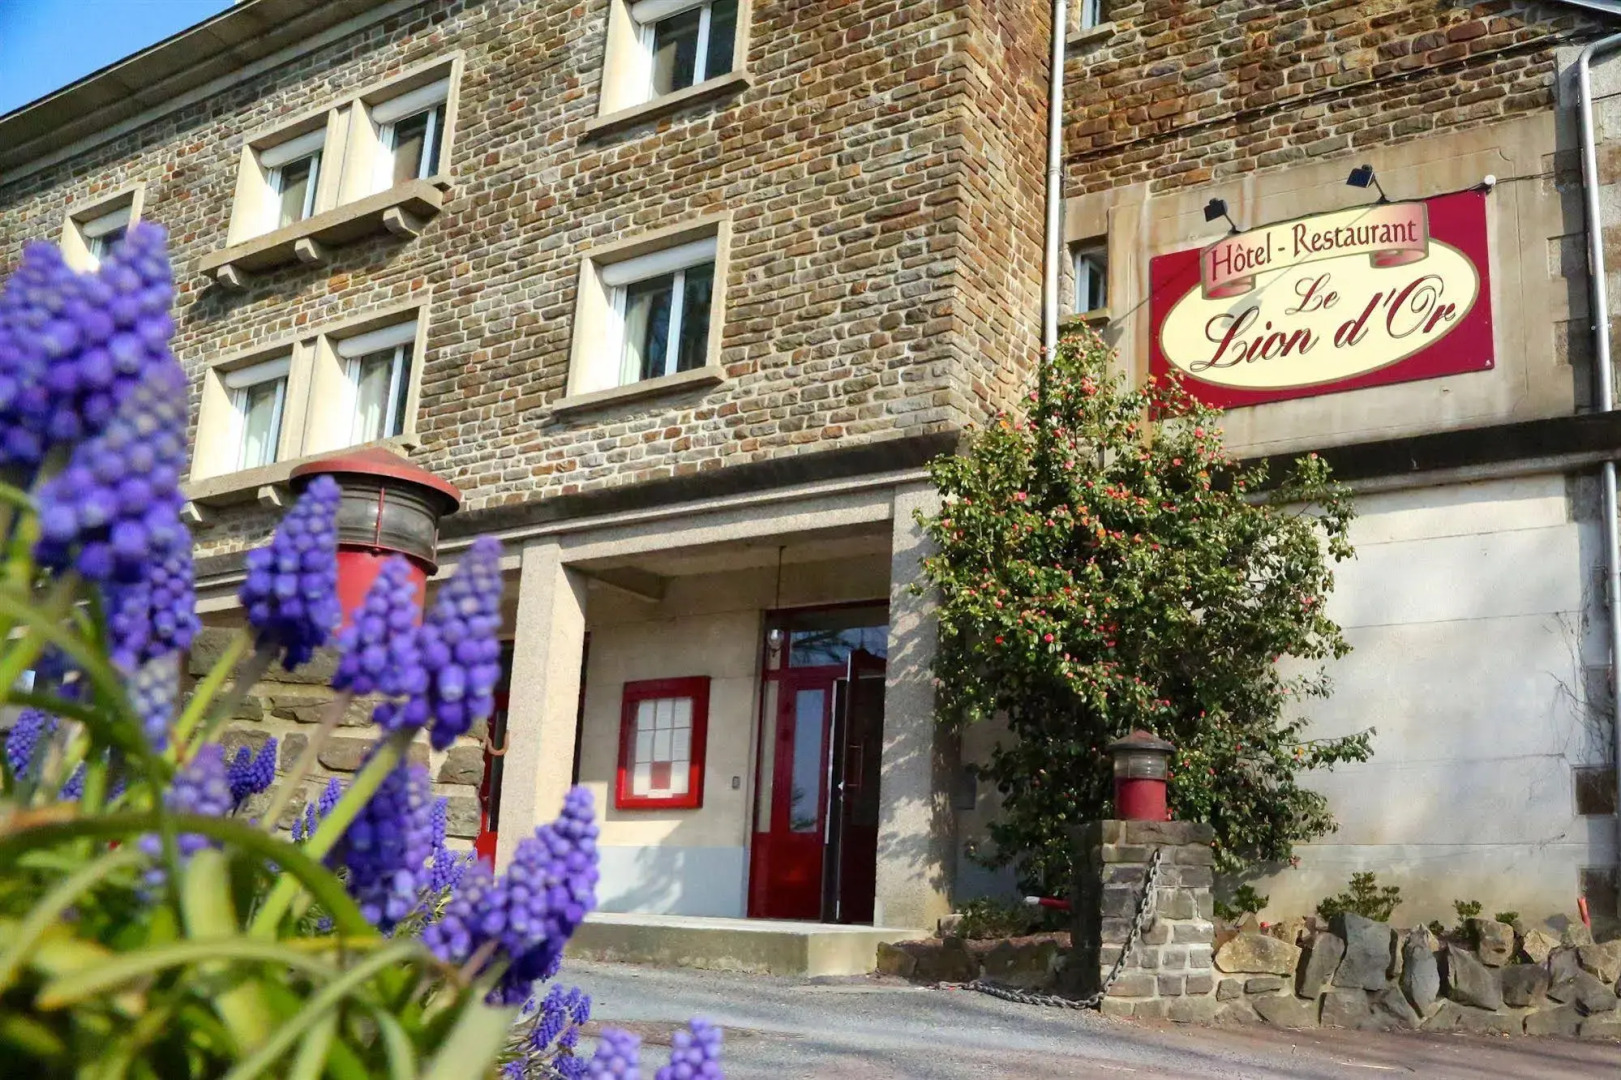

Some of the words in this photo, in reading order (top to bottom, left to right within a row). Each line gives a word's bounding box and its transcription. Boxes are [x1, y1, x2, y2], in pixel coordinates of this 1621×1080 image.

[1211, 232, 1272, 281] Hôtel
[1292, 219, 1418, 257] Restaurant
[1189, 305, 1320, 372] Lion
[1333, 274, 1456, 349] d'Or
[1284, 272, 1341, 316] Le
